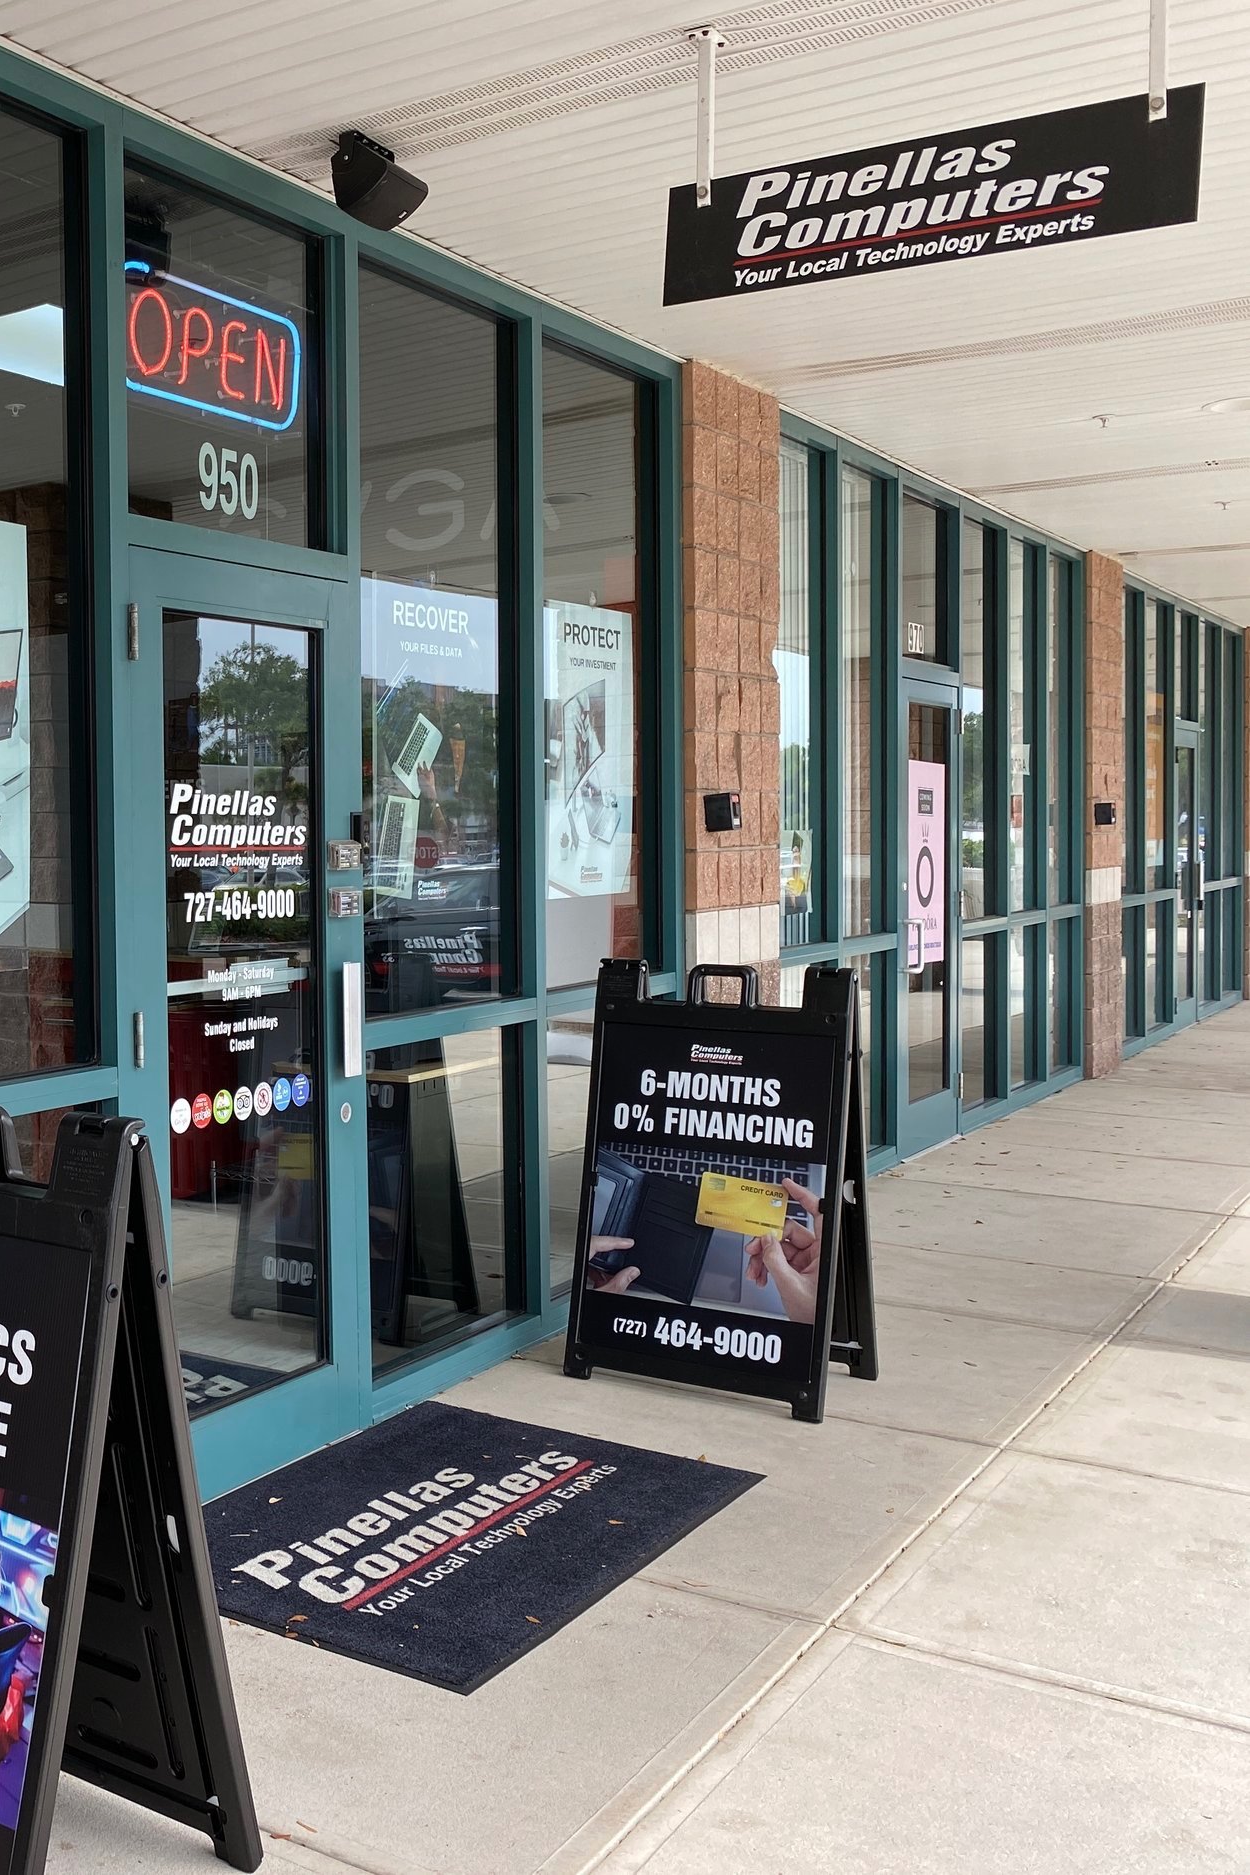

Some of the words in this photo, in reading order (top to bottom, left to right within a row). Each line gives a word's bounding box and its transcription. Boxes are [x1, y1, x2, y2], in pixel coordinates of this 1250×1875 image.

[736, 138, 1017, 219] Pinellas
[736, 165, 1110, 258] Computers
[733, 264, 782, 288] Your
[785, 253, 848, 280] Local
[854, 231, 991, 269] Technology
[995, 212, 1095, 248] Experts
[129, 288, 286, 411] OPEN
[198, 441, 259, 520] 950
[393, 600, 470, 636] RECOVER
[399, 639, 420, 654] YOUR
[420, 642, 440, 657] FILES
[445, 646, 463, 659] DATA
[563, 621, 622, 652] PROTECT
[909, 623, 924, 653] 970
[569, 656, 585, 669] YOUR
[586, 658, 617, 672] INVESTMENT
[169, 783, 277, 816] Pinellas
[170, 814, 307, 849] Computers
[170, 855, 192, 868] Your
[193, 854, 218, 867] Local
[221, 853, 270, 869] Technology
[272, 852, 303, 867] Experts
[183, 888, 295, 923] 727-464-9000
[207, 969, 237, 983] Monday
[243, 966, 275, 980] Saturday
[222, 986, 239, 1001] 9AM
[245, 985, 262, 999] 6PM
[204, 1021, 231, 1037] Sunday
[233, 1018, 247, 1033] and
[248, 1015, 279, 1031] Holidays
[229, 1036, 255, 1053] Closed
[690, 1050, 744, 1061] Computers
[691, 1044, 732, 1054] Pinellas
[640, 1068, 781, 1107] 6-MONTHS
[613, 1102, 654, 1134] 0%
[664, 1106, 815, 1149] FINANCING
[740, 1184, 764, 1195] CREDIT
[765, 1189, 784, 1199] CARD
[613, 1317, 647, 1338] (727)
[653, 1316, 782, 1364] 464-9000
[235, 1464, 475, 1589] Pinellas
[299, 1449, 580, 1604] Computers
[359, 1580, 411, 1619] Your
[416, 1552, 469, 1589] Local
[464, 1496, 564, 1557] Technology
[557, 1462, 618, 1500] Experts
